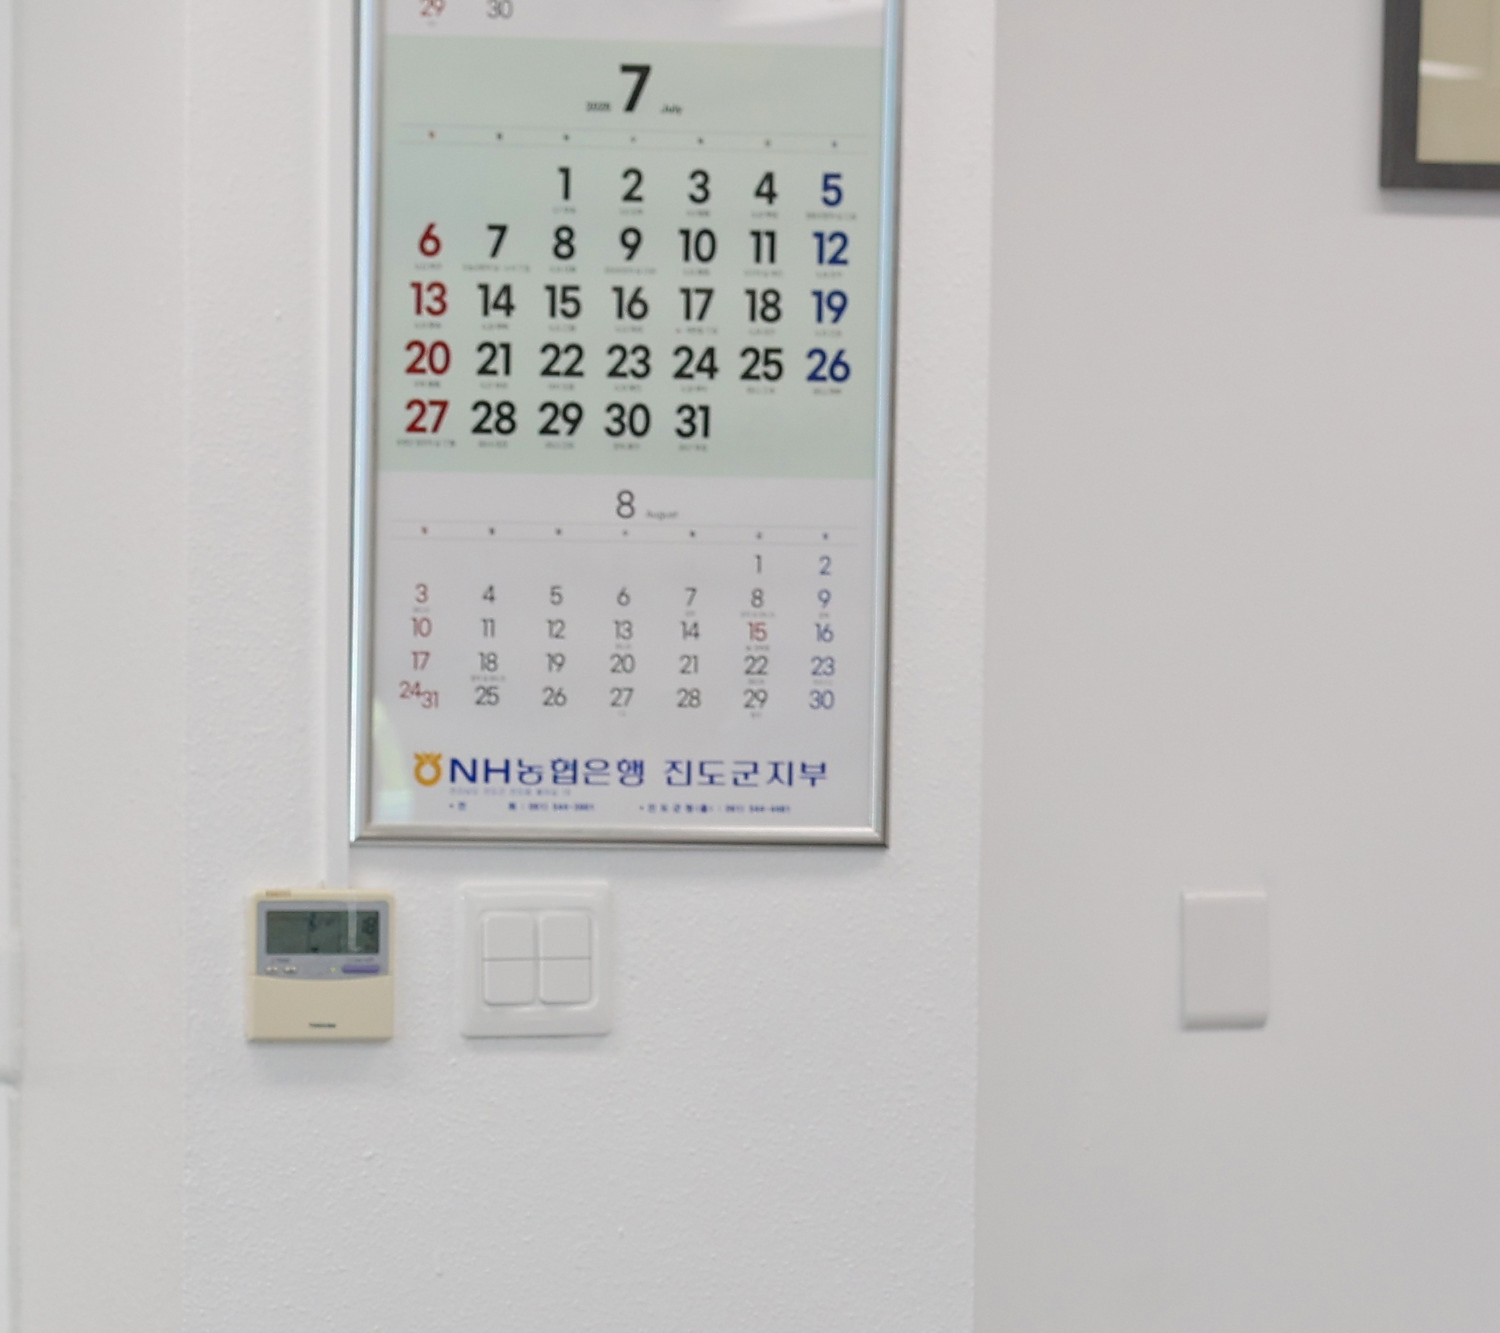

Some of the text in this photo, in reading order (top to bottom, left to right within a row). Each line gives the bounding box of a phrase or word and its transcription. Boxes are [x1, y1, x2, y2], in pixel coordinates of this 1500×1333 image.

[488, 0, 512, 19] 30
[620, 63, 652, 113] 7
[558, 166, 843, 207] 1 2 3 4 5
[418, 222, 849, 266] 6 7 8 9 10 11 12
[410, 281, 848, 324] 13 14 15 16 17 18 19
[405, 339, 851, 383] 20 21 22 23 24 25 26
[405, 398, 710, 439] 27 28 29 30 31
[616, 489, 636, 519] 8
[755, 553, 832, 576] 1 2
[415, 582, 832, 609] 3 4 5 6 7 8 9
[411, 616, 834, 643] 10 11 12 13 14 15 16
[411, 650, 835, 677] 17 18 19 20 21 22 23
[399, 680, 835, 710] 24 31 25 26 27 28 29 30
[666, 760, 826, 787] 진도군지부
